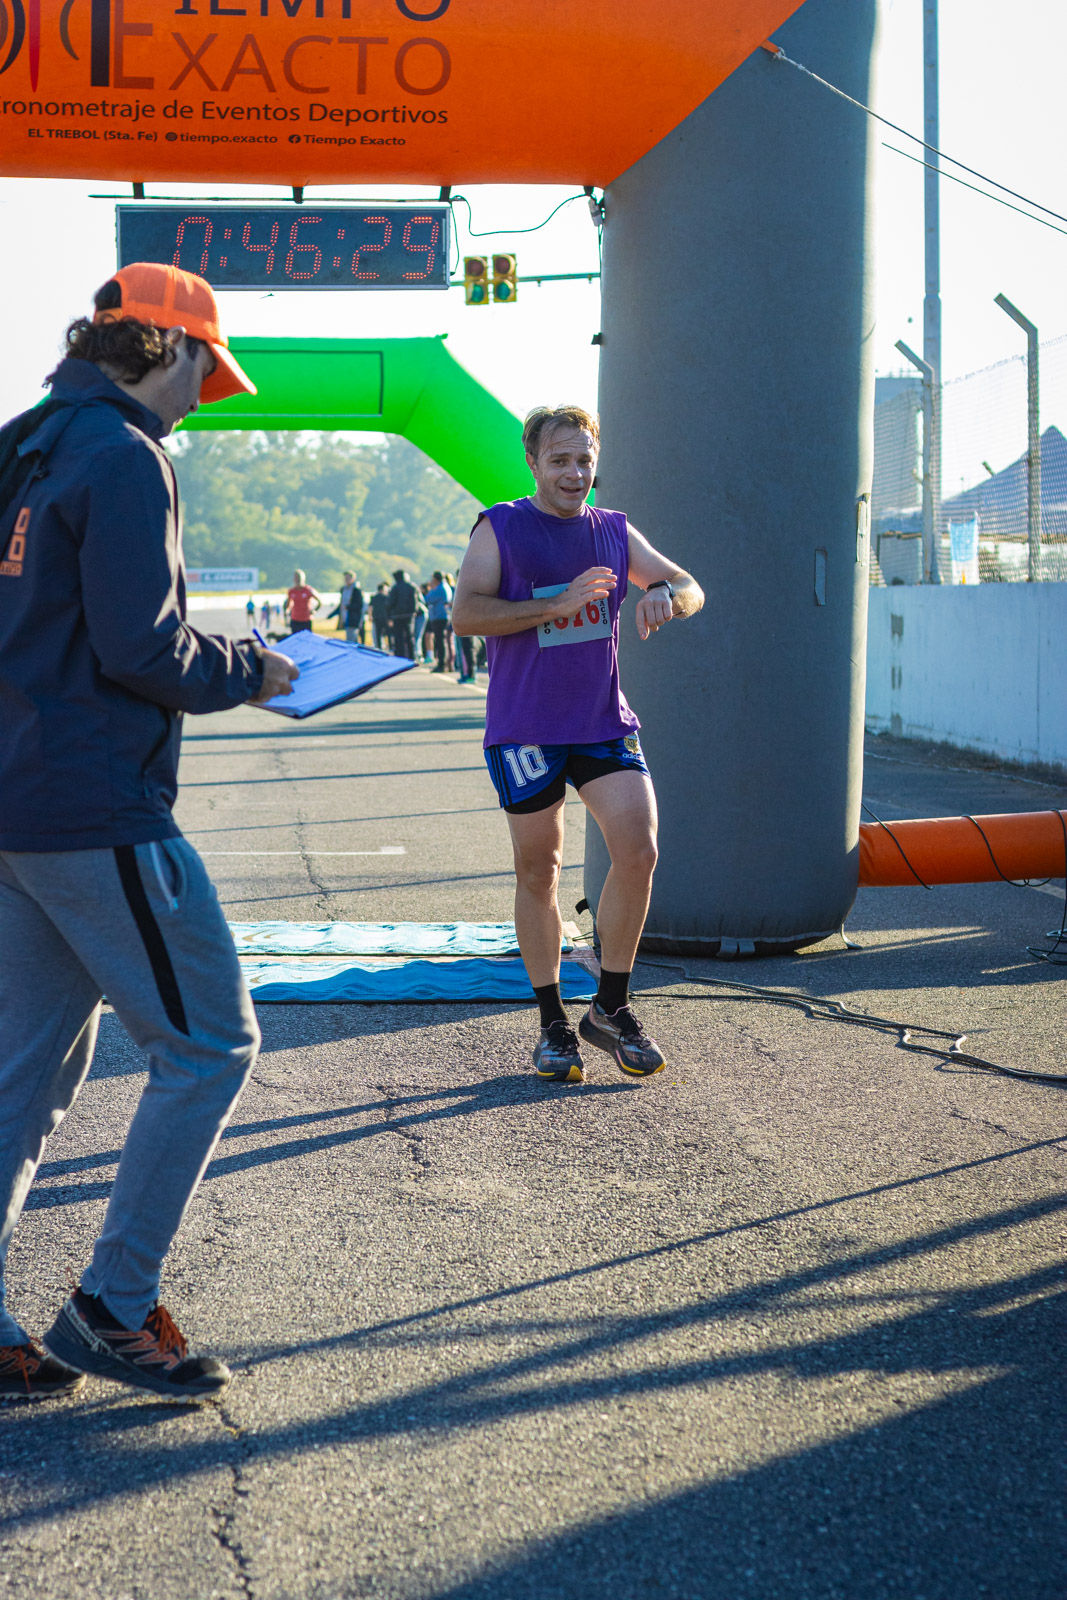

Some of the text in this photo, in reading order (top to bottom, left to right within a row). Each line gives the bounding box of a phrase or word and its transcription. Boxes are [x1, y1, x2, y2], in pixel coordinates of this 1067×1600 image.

[0, 99, 448, 126] ronometraje de Eventos Deportivos
[28, 128, 158, 142] EL TREBOL (Sta. Fe)
[180, 133, 278, 144] tiempo.exacto
[304, 134, 406, 146] Tiempo Exacto
[172, 216, 440, 280] 0:46:29
[504, 744, 549, 788] 10
